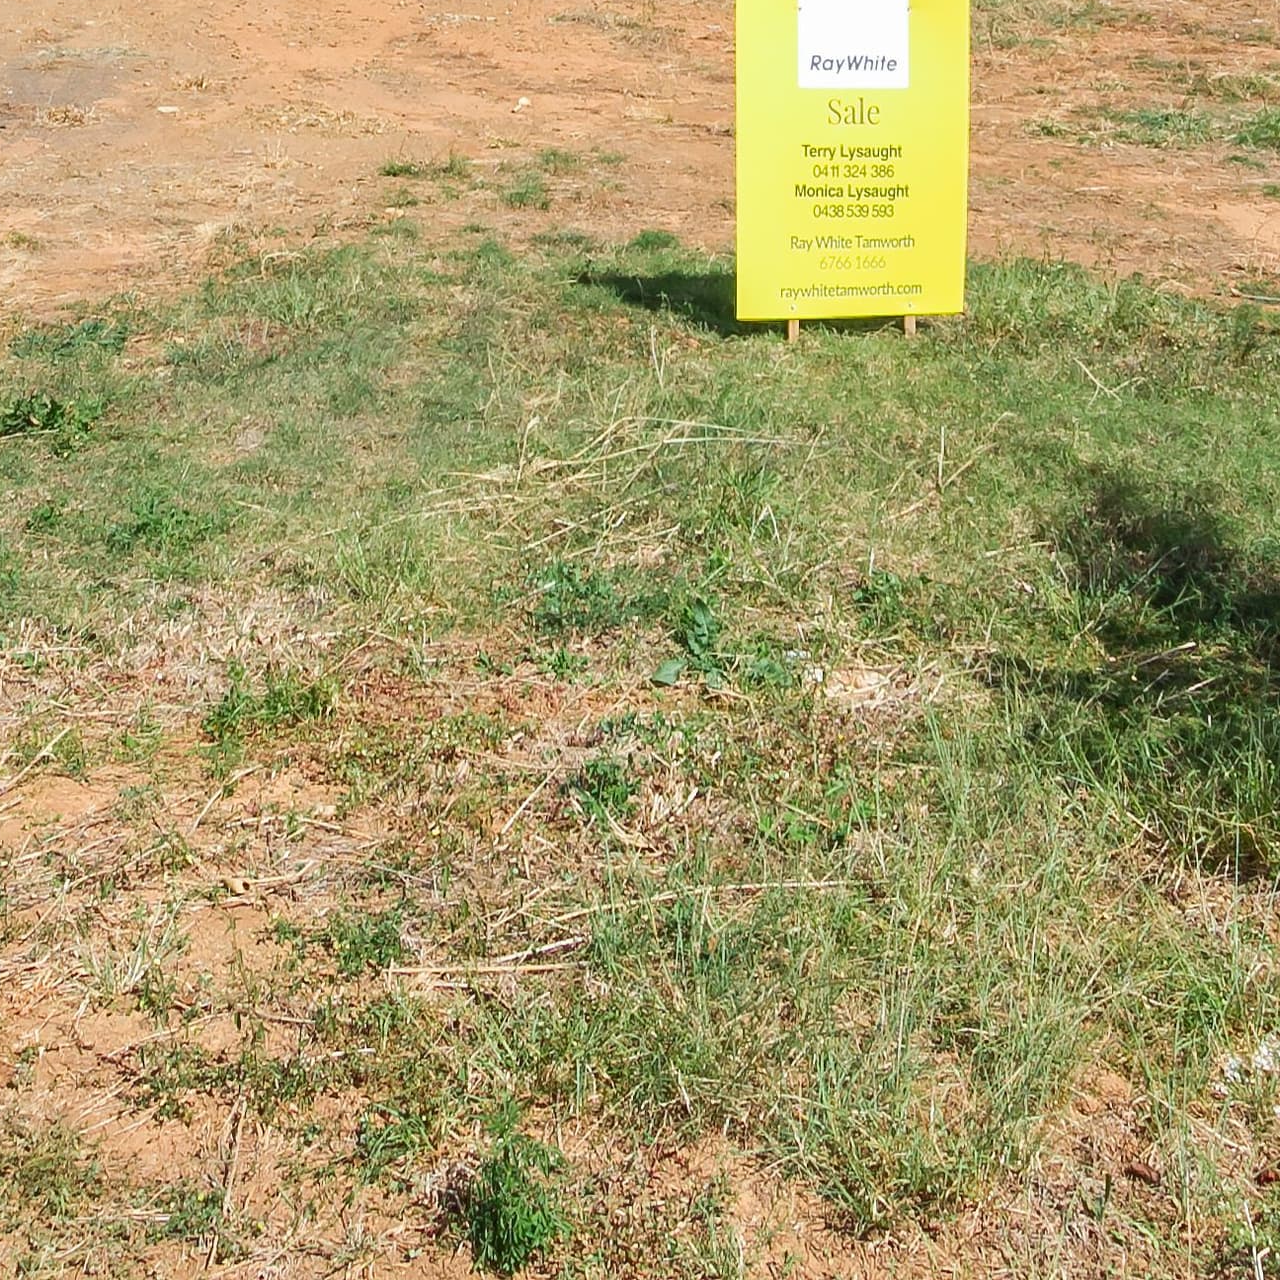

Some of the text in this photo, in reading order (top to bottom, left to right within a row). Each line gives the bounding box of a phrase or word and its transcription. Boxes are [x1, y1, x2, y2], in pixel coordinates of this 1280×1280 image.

[828, 97, 880, 125] Sale
[802, 144, 902, 161] Terry Lysaught
[813, 164, 895, 178] 0411 324 386
[795, 184, 910, 201] Monica Lysaught
[813, 204, 894, 218] 0438 539 593
[790, 234, 915, 252] Ray White Tamworth
[820, 255, 886, 270] 6766 1666
[780, 282, 923, 300] raywhitetamworth.com
